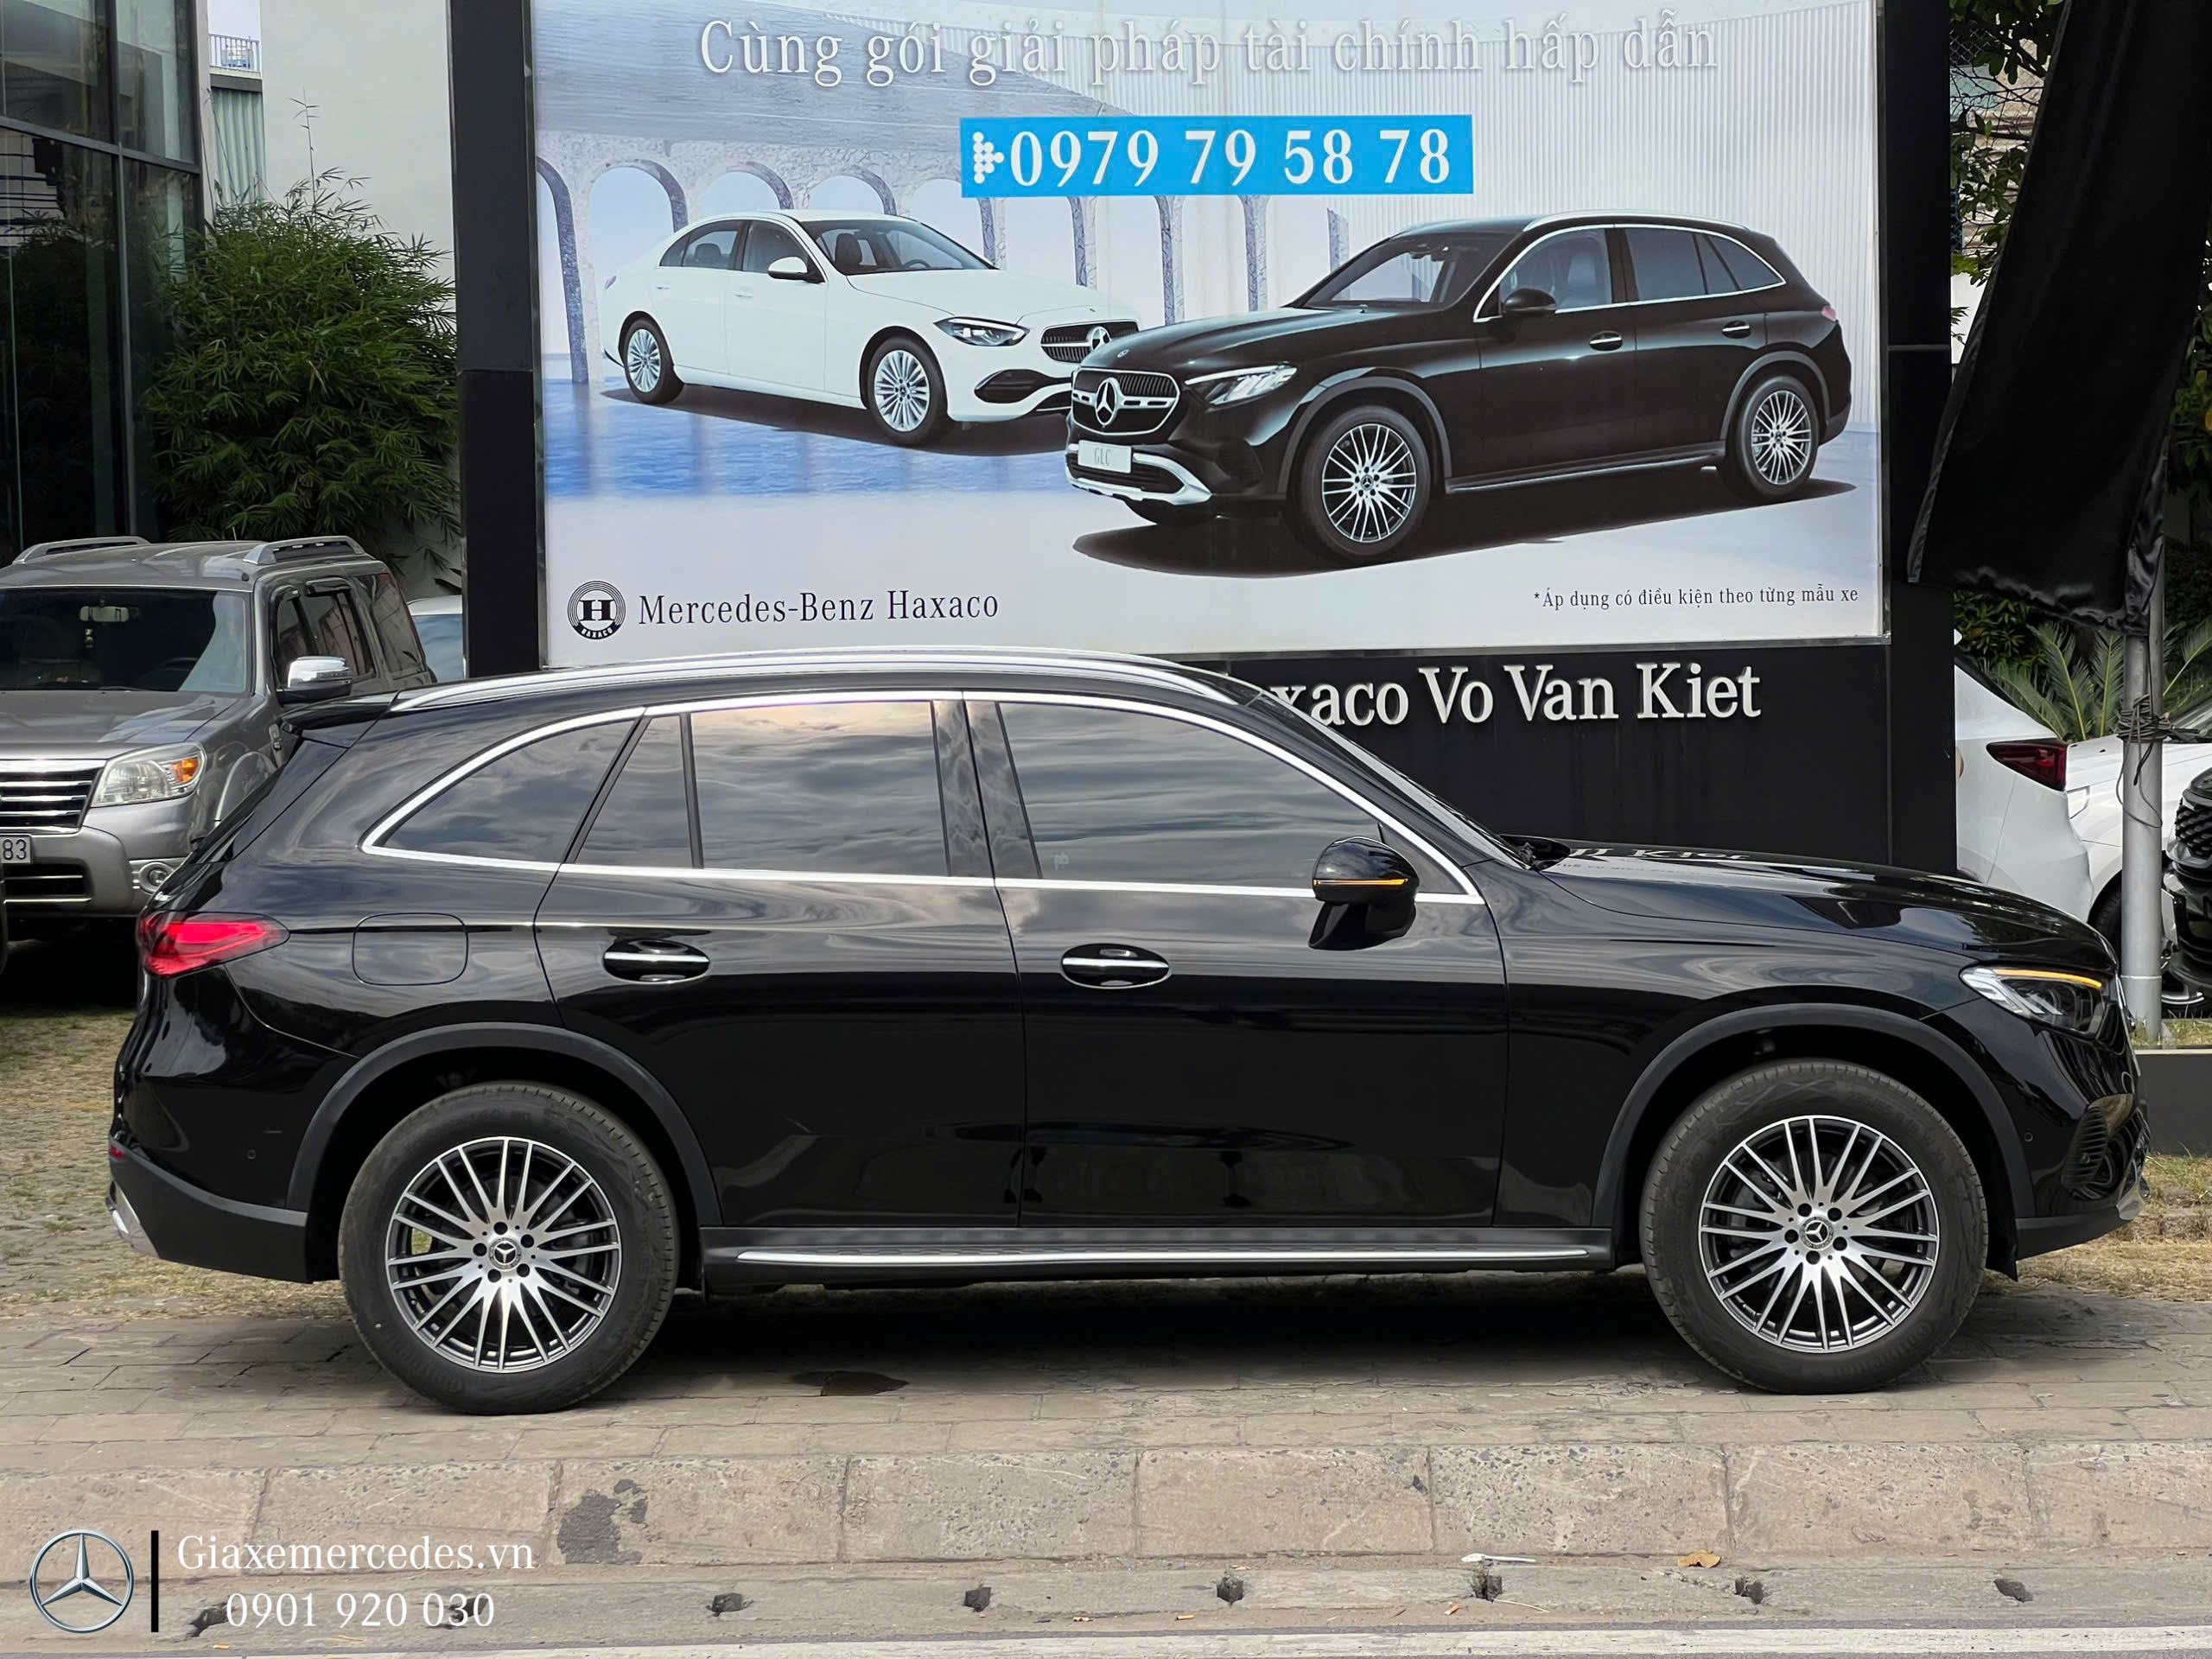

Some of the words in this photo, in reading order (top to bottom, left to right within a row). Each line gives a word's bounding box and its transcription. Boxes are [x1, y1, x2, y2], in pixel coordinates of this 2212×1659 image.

[701, 19, 842, 87] Cùng
[867, 26, 943, 87] gói
[969, 19, 1065, 87] giải
[1091, 21, 1222, 86] pháp
[1244, 21, 1312, 71] tài
[1333, 19, 1480, 71] chính
[1505, 12, 1600, 84] hấp
[1623, 9, 1718, 68] dẫn
[1011, 130, 1160, 188] 0979
[1186, 130, 1257, 186] 79
[1283, 130, 1353, 185] 58
[1379, 129, 1451, 184] 78
[1094, 447, 1111, 467] GLC
[579, 599, 615, 621] H
[639, 593, 874, 625] Mercedes-Benz
[887, 589, 999, 620] Haxaco
[1570, 590, 1610, 610] dụng
[1615, 588, 1632, 606] có
[1638, 588, 1672, 606] điều
[1679, 588, 1713, 608] kiện
[1719, 588, 1753, 603] theo
[1760, 587, 1796, 605] từng
[1802, 582, 1834, 602] mẫu
[1841, 589, 1859, 601] xe
[581, 627, 613, 638] HAXACO
[1418, 666, 1494, 724] Vo
[1503, 664, 1618, 721] Van
[1637, 663, 1762, 718] Kiet
[3, 839, 27, 860] 83
